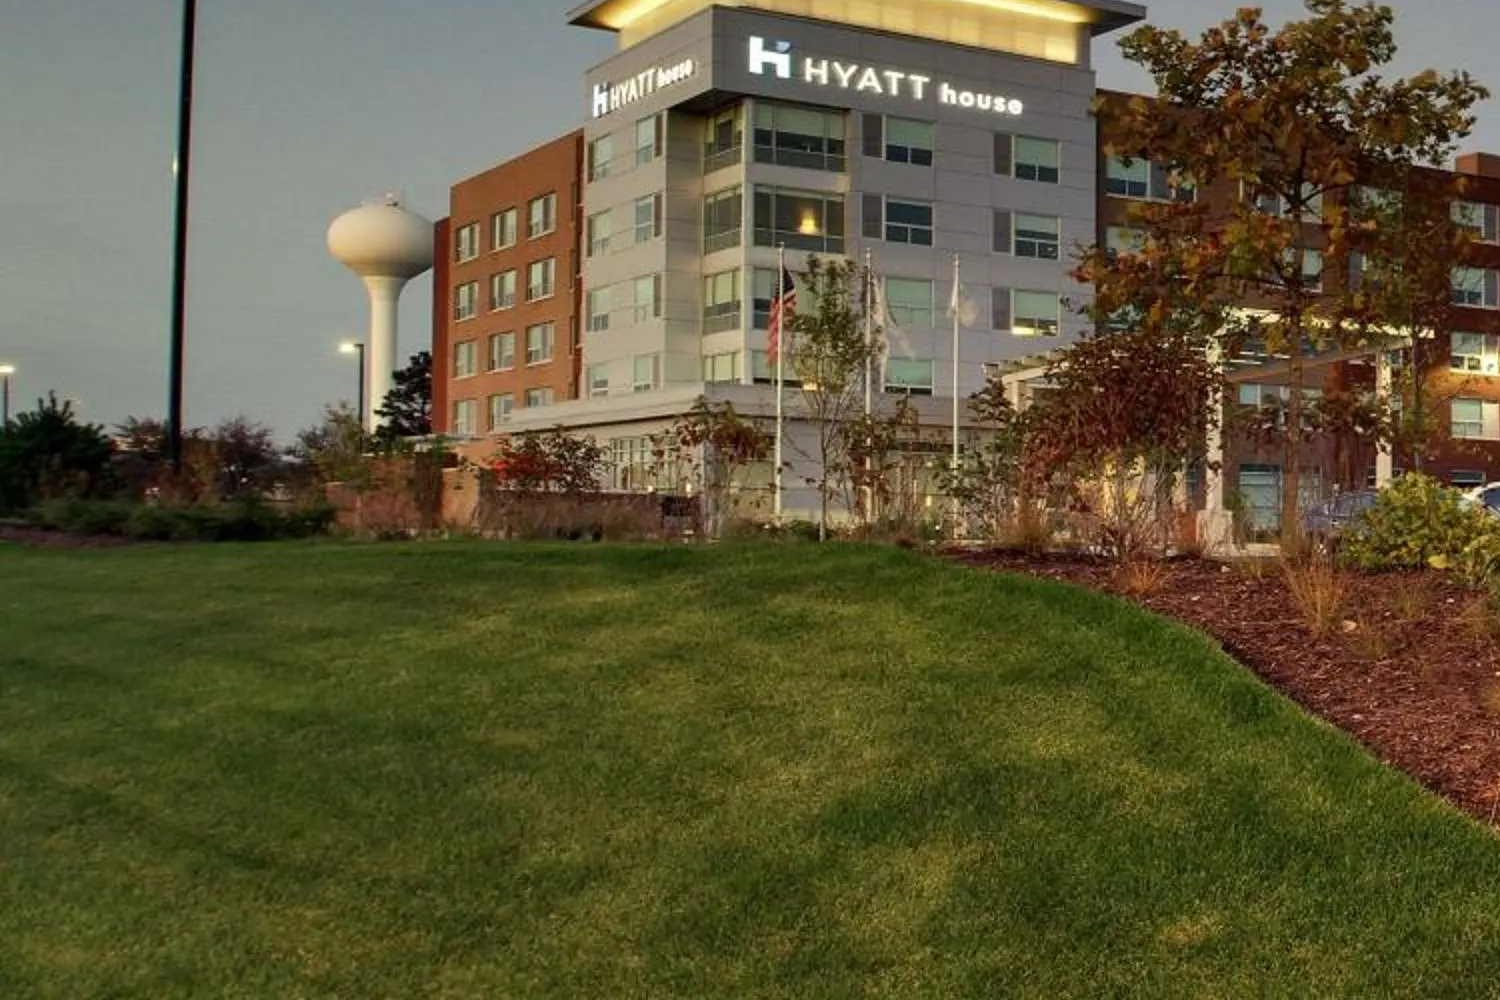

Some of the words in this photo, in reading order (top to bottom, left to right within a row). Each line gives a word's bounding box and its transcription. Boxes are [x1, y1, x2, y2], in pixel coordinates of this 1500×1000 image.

[610, 67, 656, 110] HYATT
[804, 57, 931, 100] HYATT
[940, 83, 1024, 116] house
